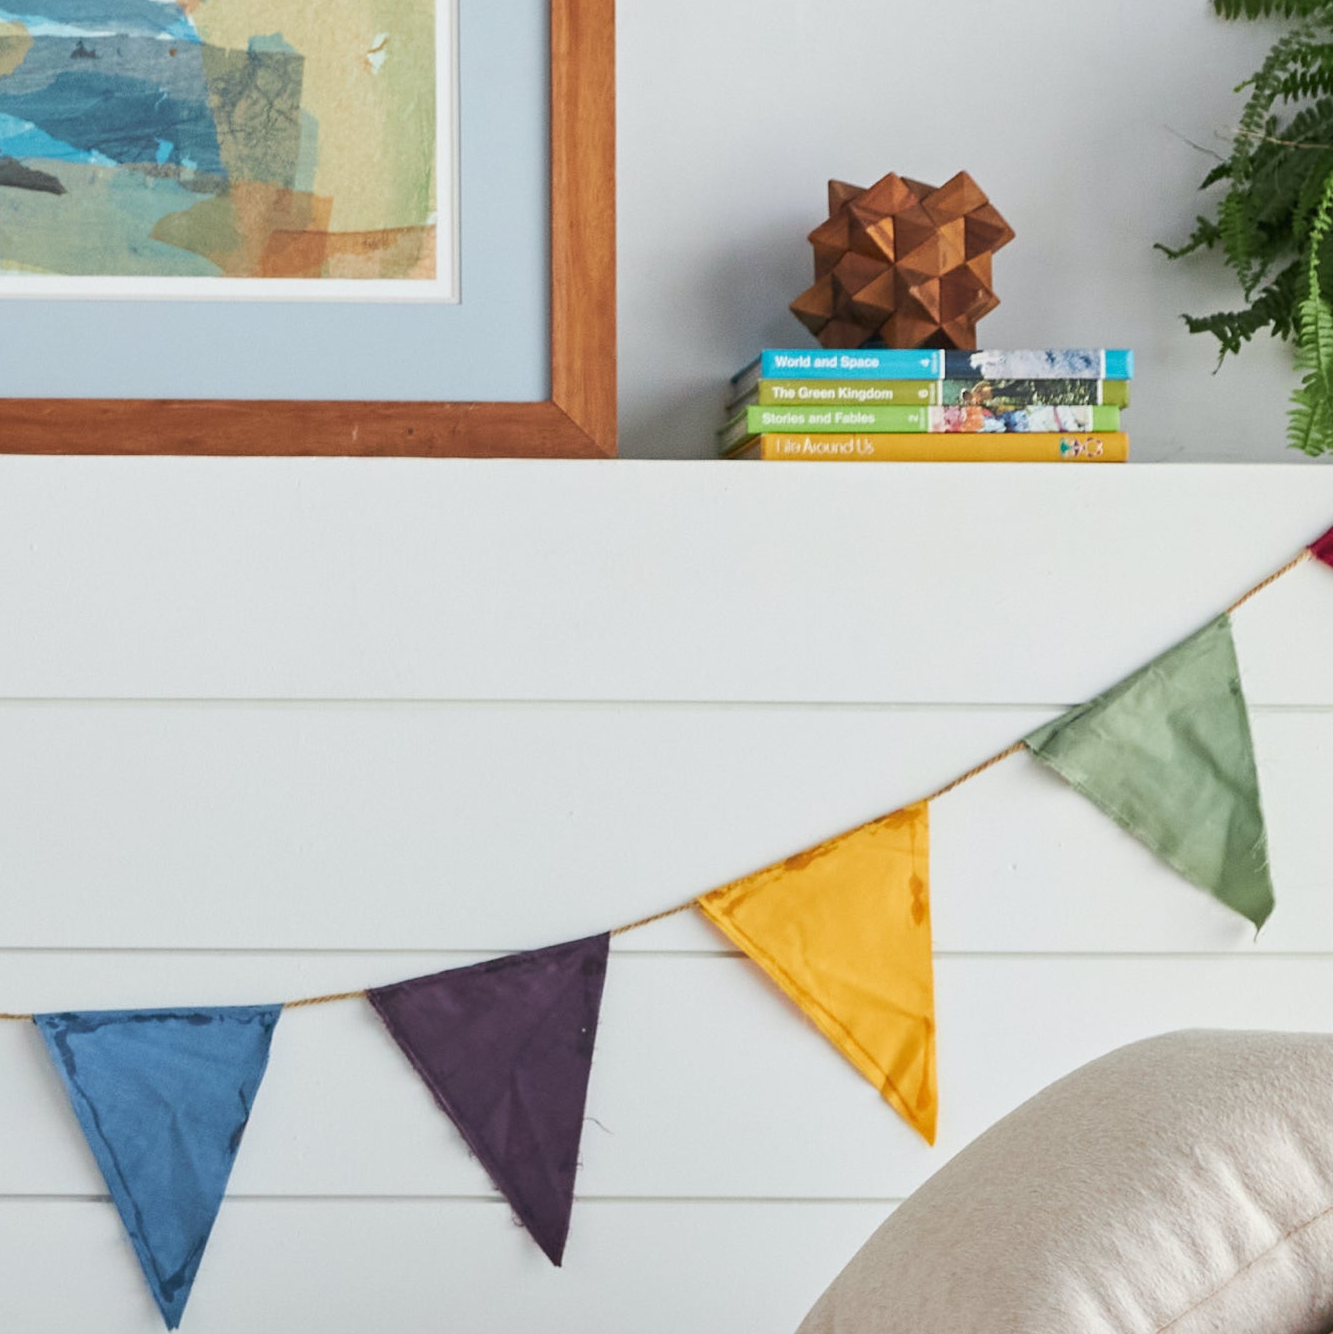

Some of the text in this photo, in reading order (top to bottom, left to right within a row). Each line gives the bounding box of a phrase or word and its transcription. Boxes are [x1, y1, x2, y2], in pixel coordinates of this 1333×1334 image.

[774, 355, 880, 370] World and Space
[772, 386, 894, 401] The Green Kingdom
[761, 411, 876, 425] Stories and Fables
[776, 436, 875, 455] Life Around Us
